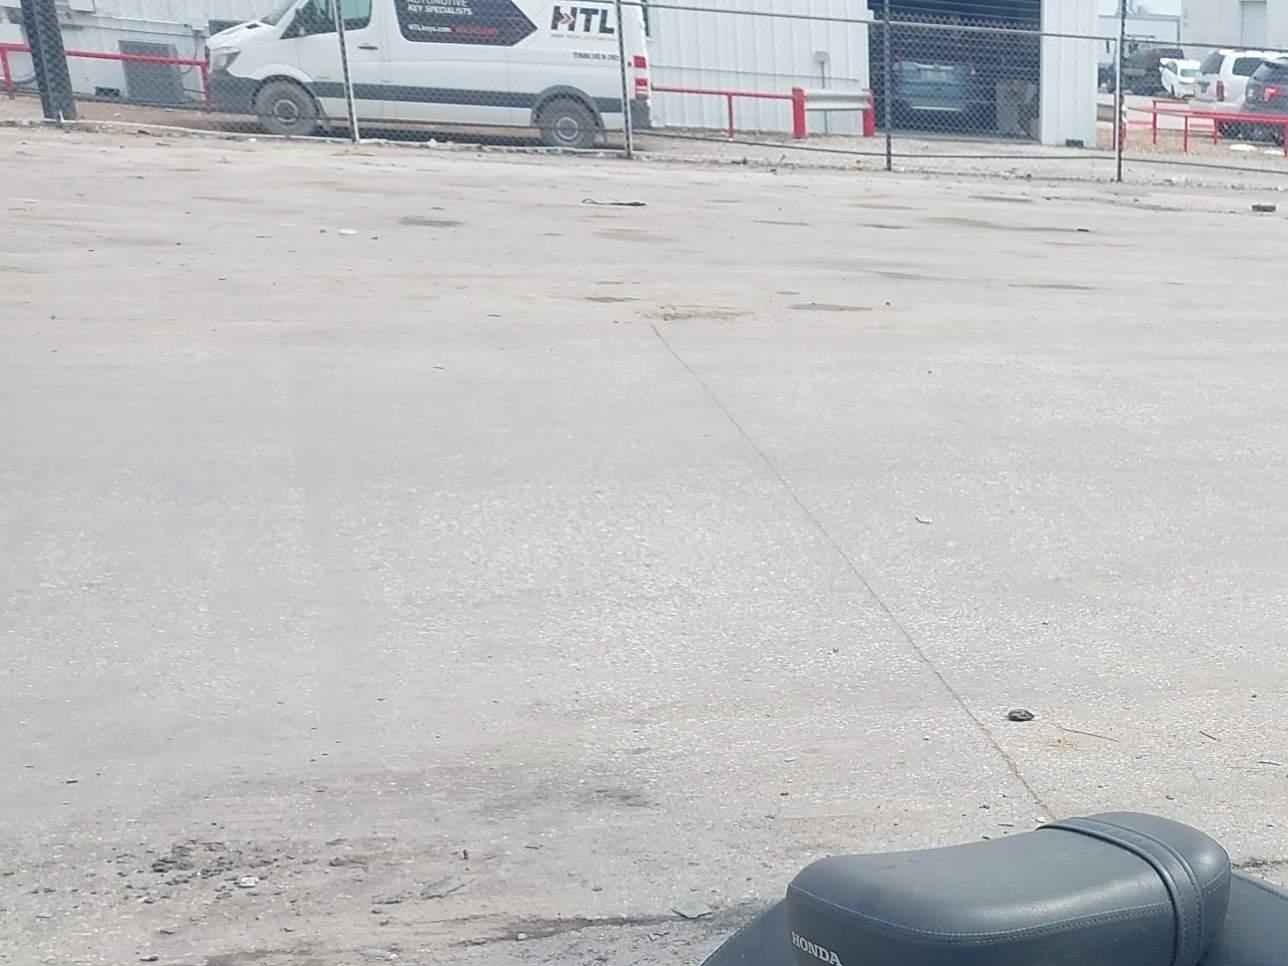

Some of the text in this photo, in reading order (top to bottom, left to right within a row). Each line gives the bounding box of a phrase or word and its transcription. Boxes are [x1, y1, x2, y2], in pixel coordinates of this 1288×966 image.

[407, 5, 473, 15] KEY SPECIALISTS
[551, 6, 615, 34] HTL
